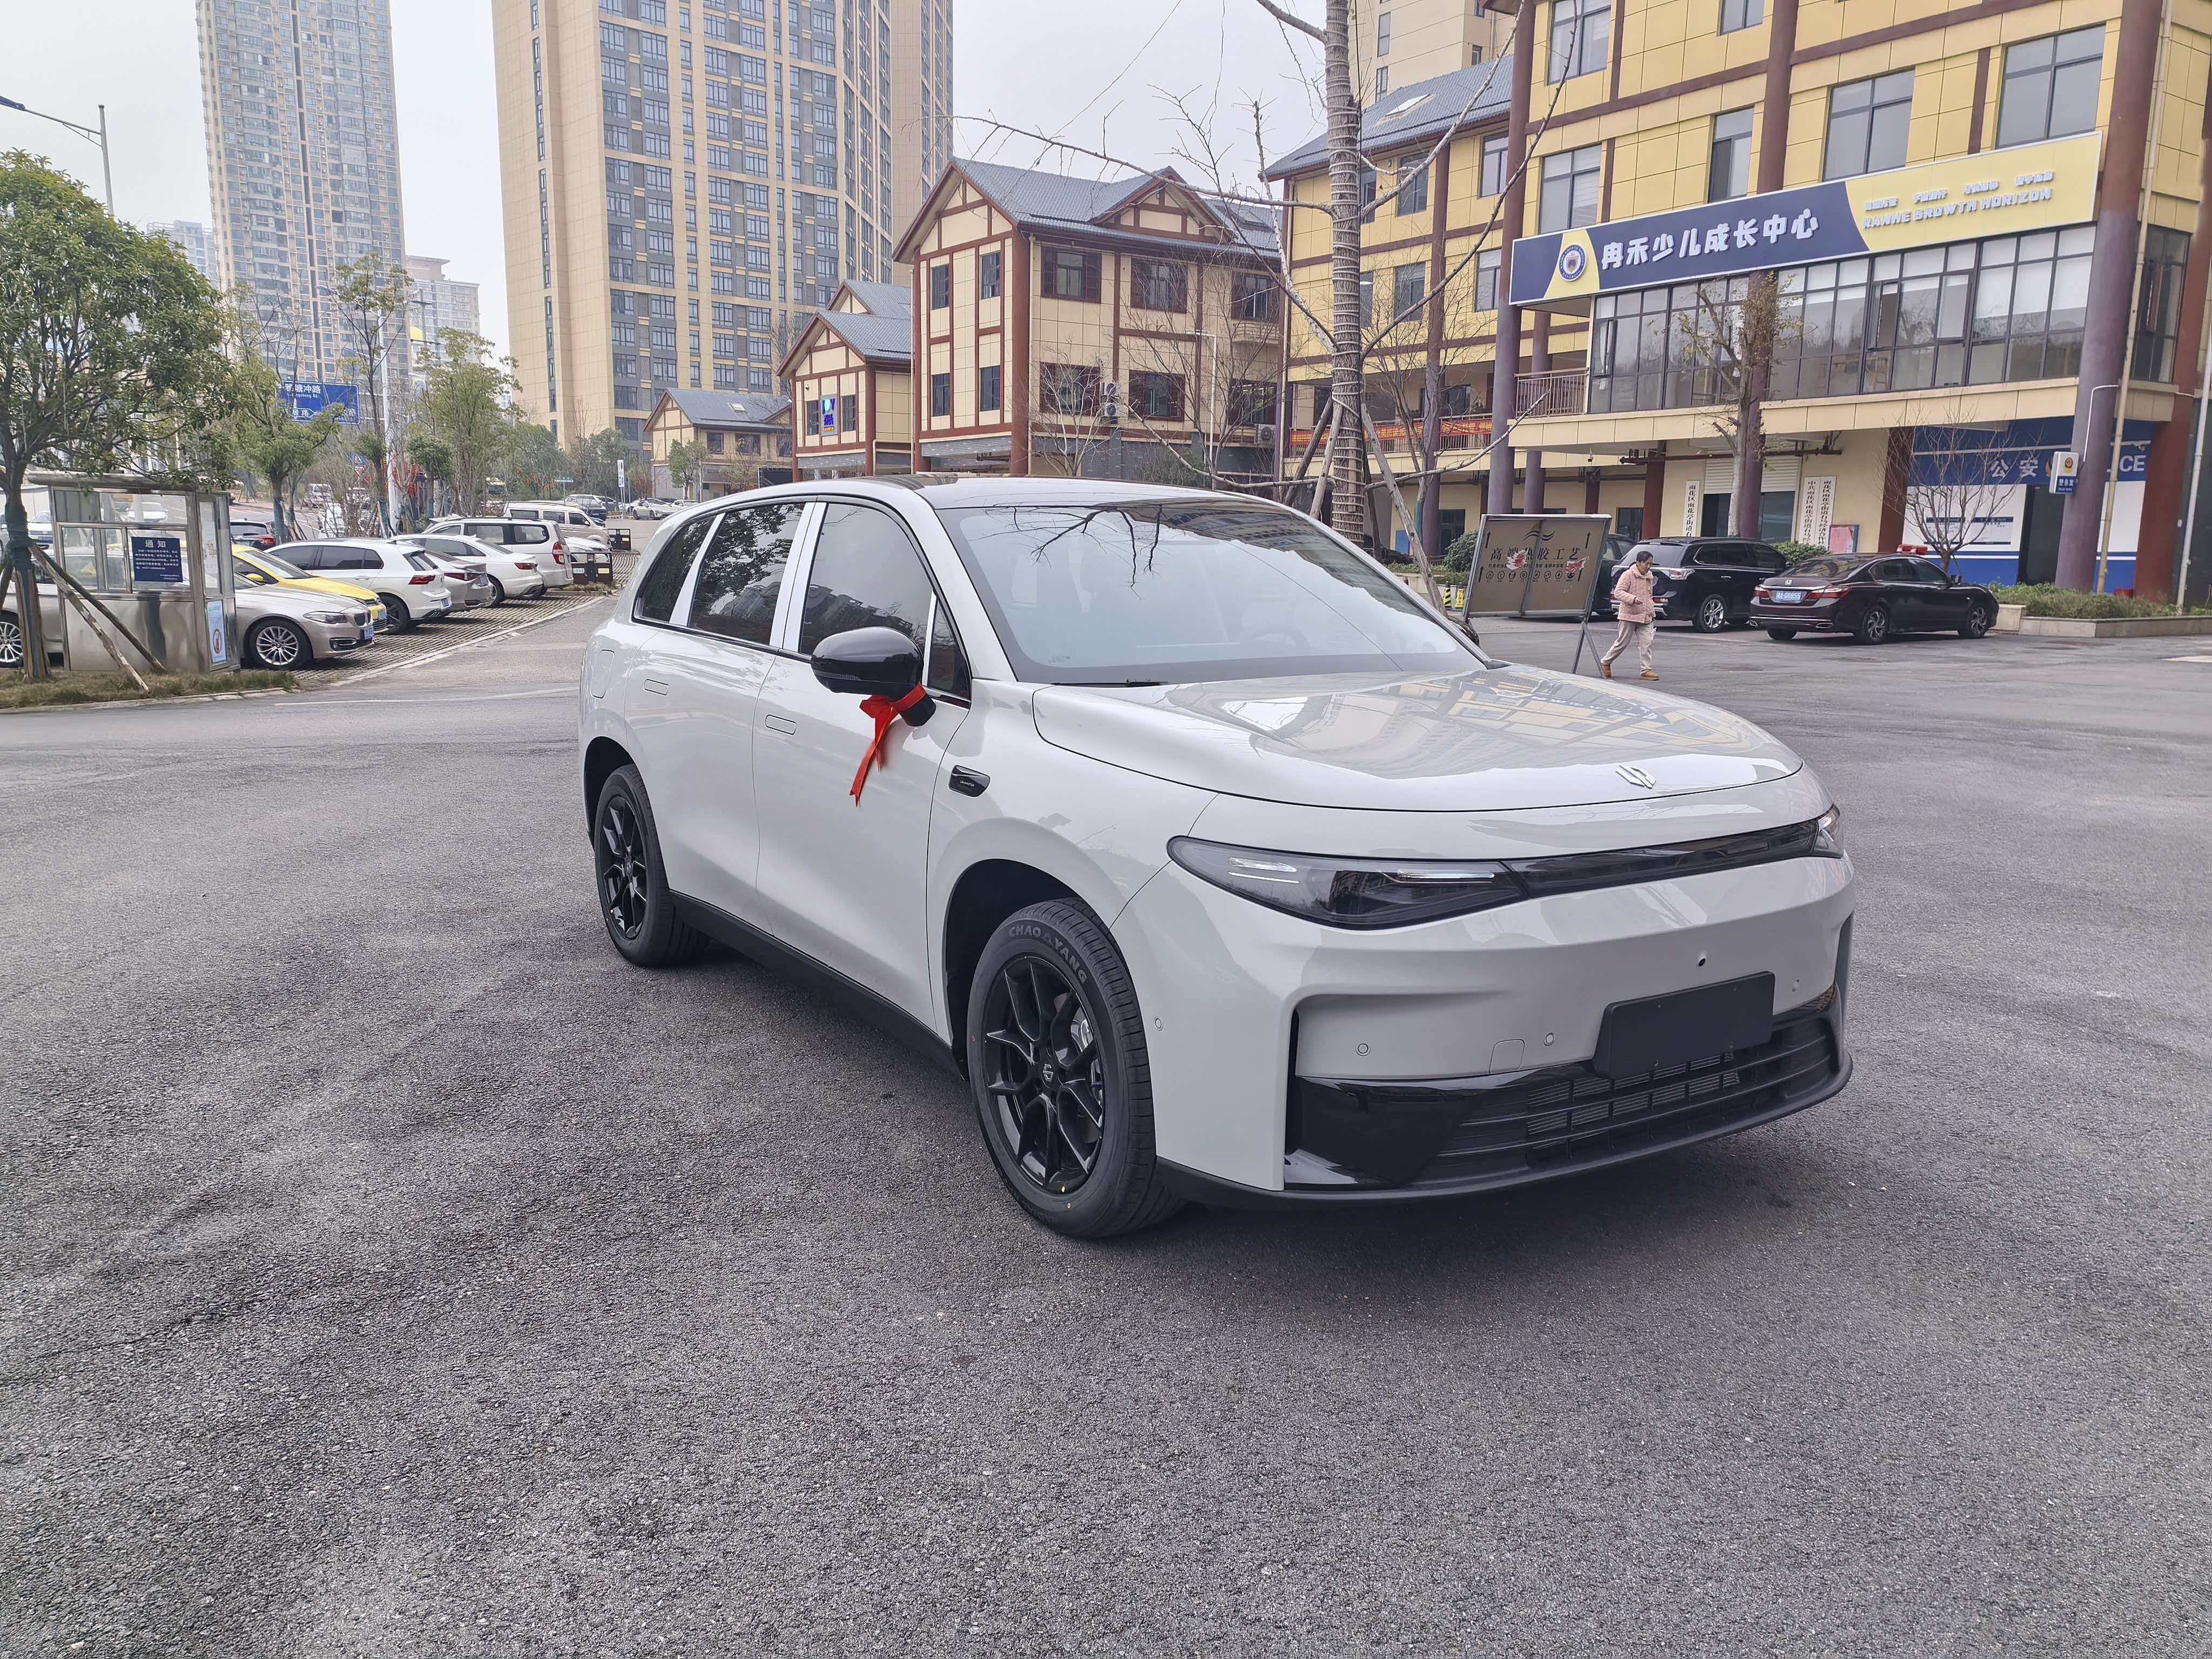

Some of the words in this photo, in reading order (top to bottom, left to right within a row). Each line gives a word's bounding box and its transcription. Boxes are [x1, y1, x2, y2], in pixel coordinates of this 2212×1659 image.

[1863, 212, 1911, 229] RANHE
[1913, 201, 1978, 221] GROWTH
[1980, 187, 2052, 210] HORIZON
[1602, 208, 1819, 269] 冉禾少儿成长中心
[1989, 458, 2039, 478] 公安
[145, 539, 166, 548] 通知
[1008, 925, 1041, 938] CHAO
[1055, 937, 1088, 984] YANG
